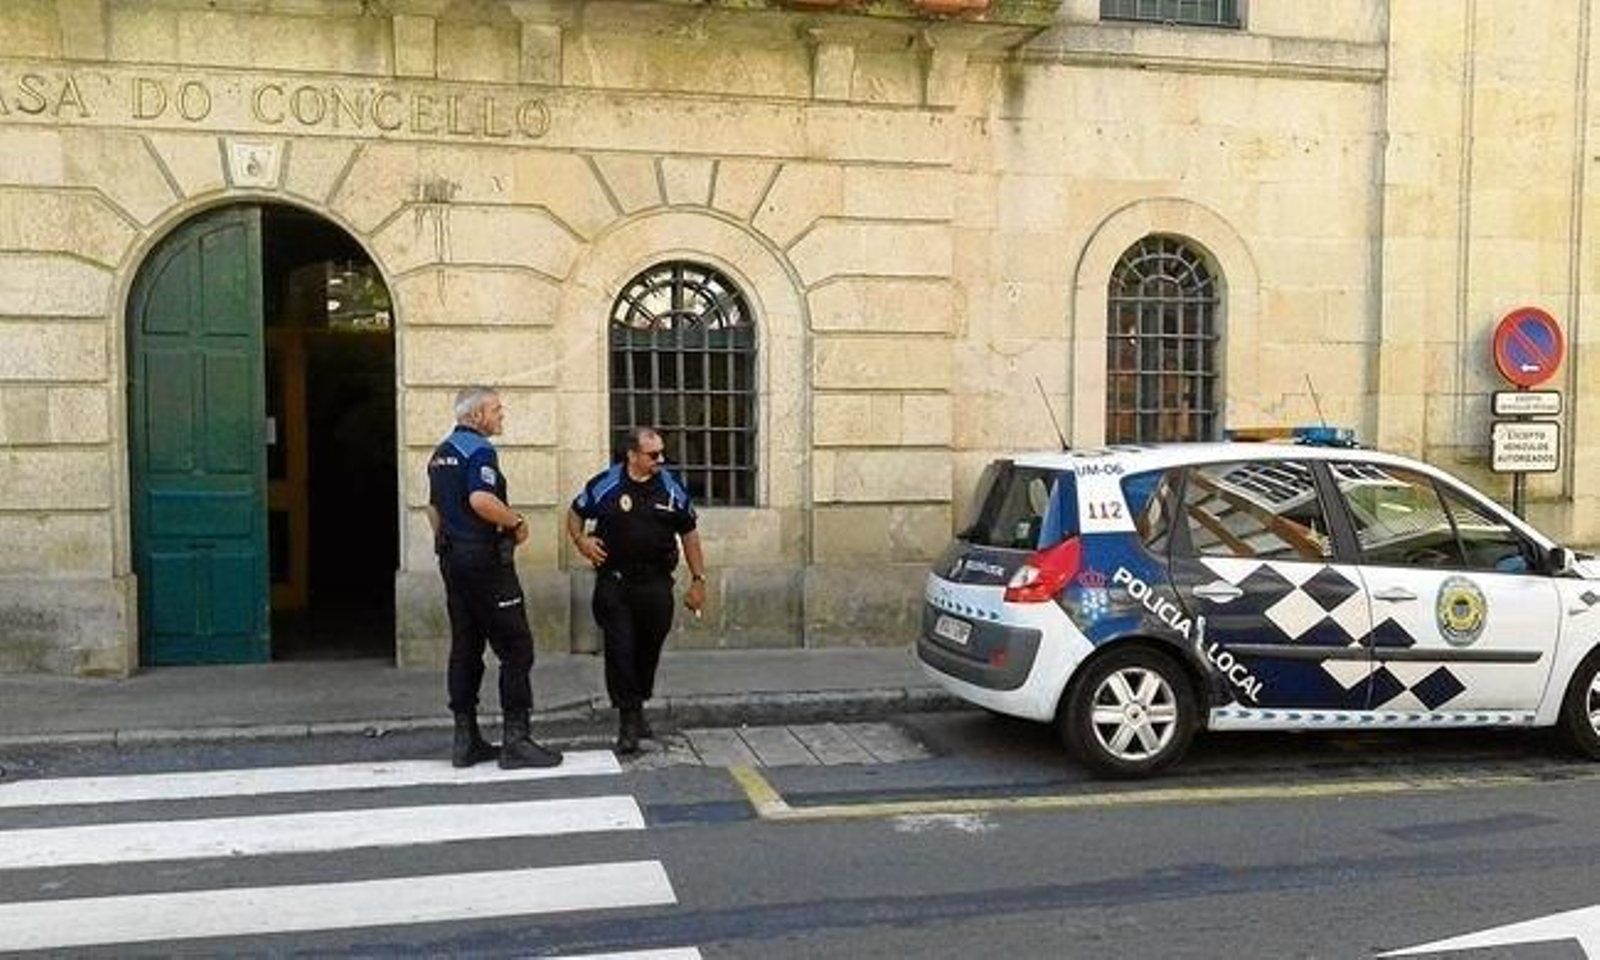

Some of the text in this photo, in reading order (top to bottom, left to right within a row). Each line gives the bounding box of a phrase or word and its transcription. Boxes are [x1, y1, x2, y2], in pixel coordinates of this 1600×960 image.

[131, 76, 212, 122] DO
[253, 84, 551, 139] CONCELLO
[1497, 453, 1555, 463] AUTORIZADOS
[1074, 462, 1125, 477] UM-06
[1088, 501, 1122, 519] 112
[1112, 566, 1263, 702] POLICIA LOCAL
